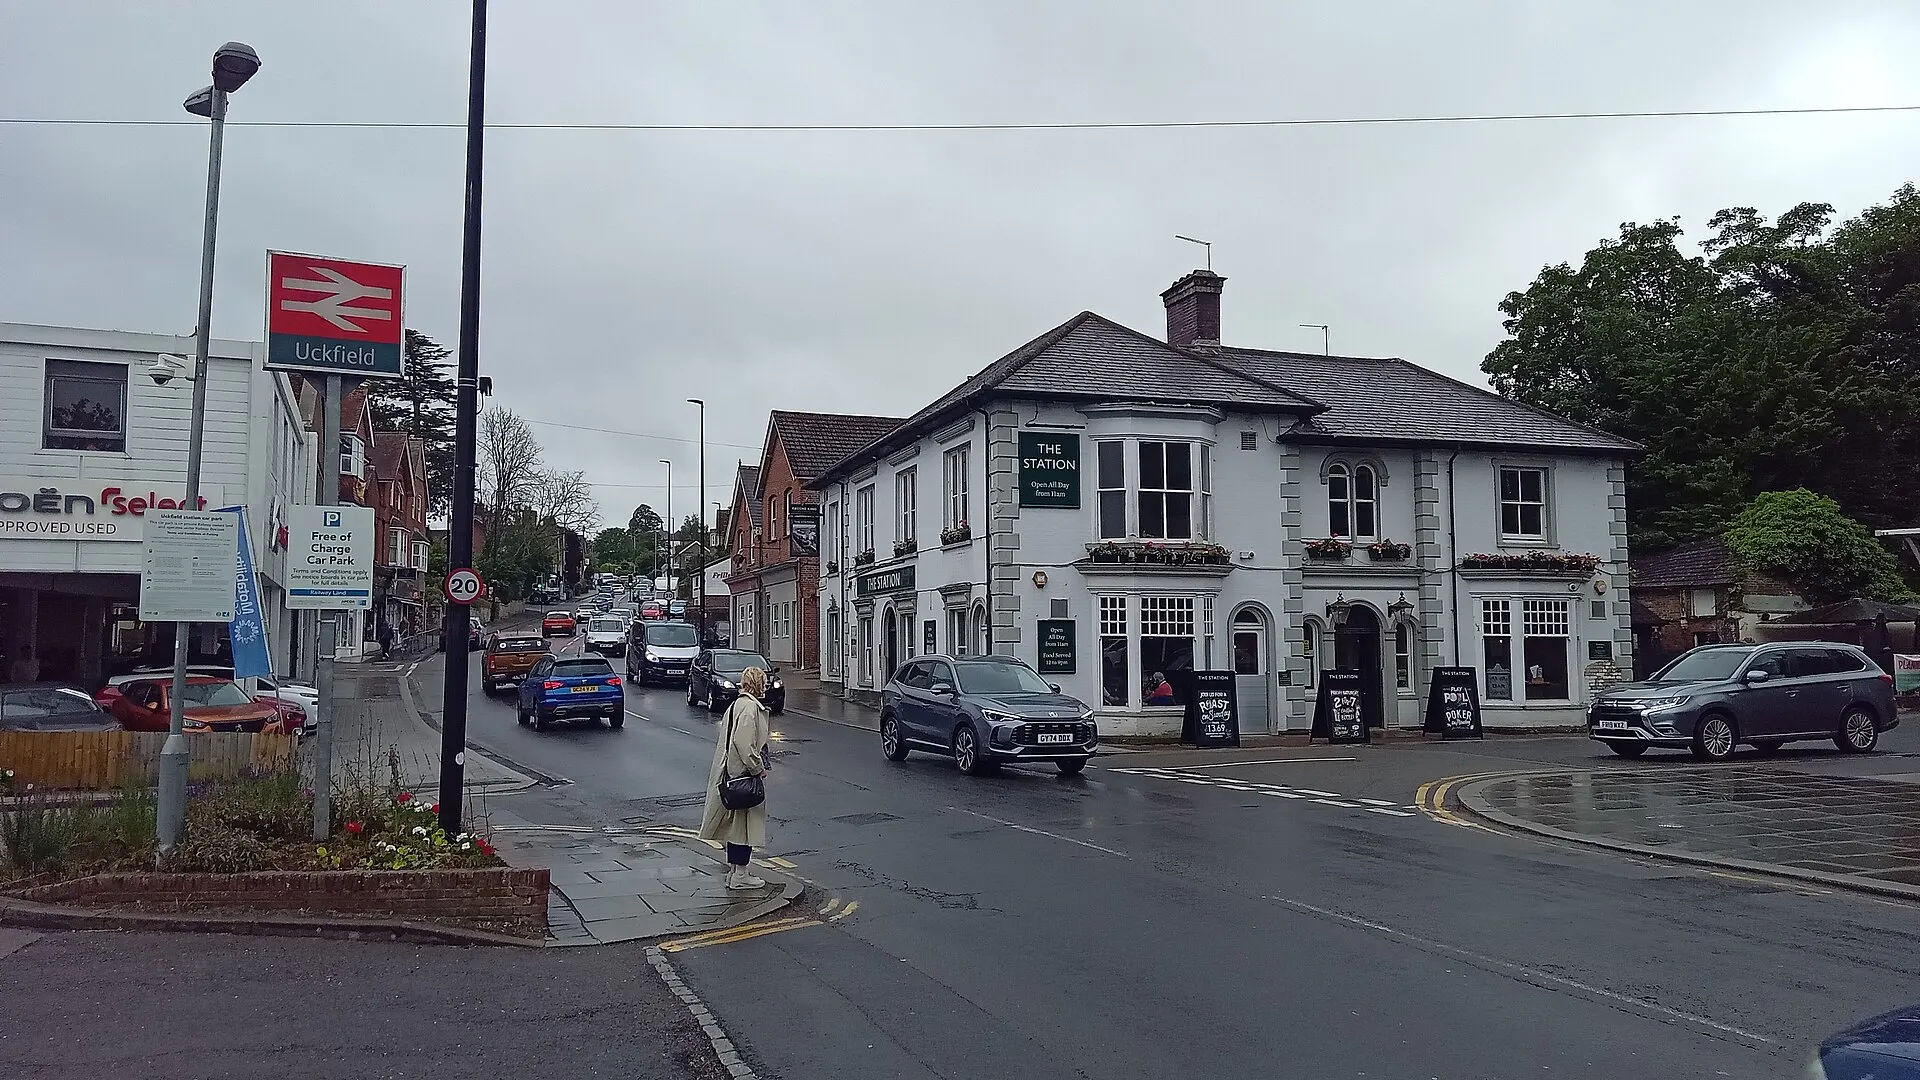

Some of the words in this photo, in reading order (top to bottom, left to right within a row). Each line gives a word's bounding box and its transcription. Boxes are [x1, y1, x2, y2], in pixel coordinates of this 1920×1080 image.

[295, 342, 375, 366] Uckfield
[1037, 443, 1062, 455] THE
[1023, 458, 1076, 470] STATION
[1031, 481, 1048, 489] Open
[1058, 481, 1070, 490] Day
[326, 512, 339, 526] P
[75, 523, 117, 535] USED
[312, 531, 337, 541] Free
[339, 531, 352, 542] of
[311, 543, 351, 556] Charge
[307, 555, 326, 565] Car
[329, 555, 355, 566] Park
[451, 578, 477, 594] 20
[866, 576, 877, 591] THE
[877, 572, 901, 590] STATION
[1199, 699, 1230, 713] ROAST
[1333, 696, 1342, 709] 2
[1445, 709, 1472, 722] POKER
[1040, 734, 1057, 742] GY74
